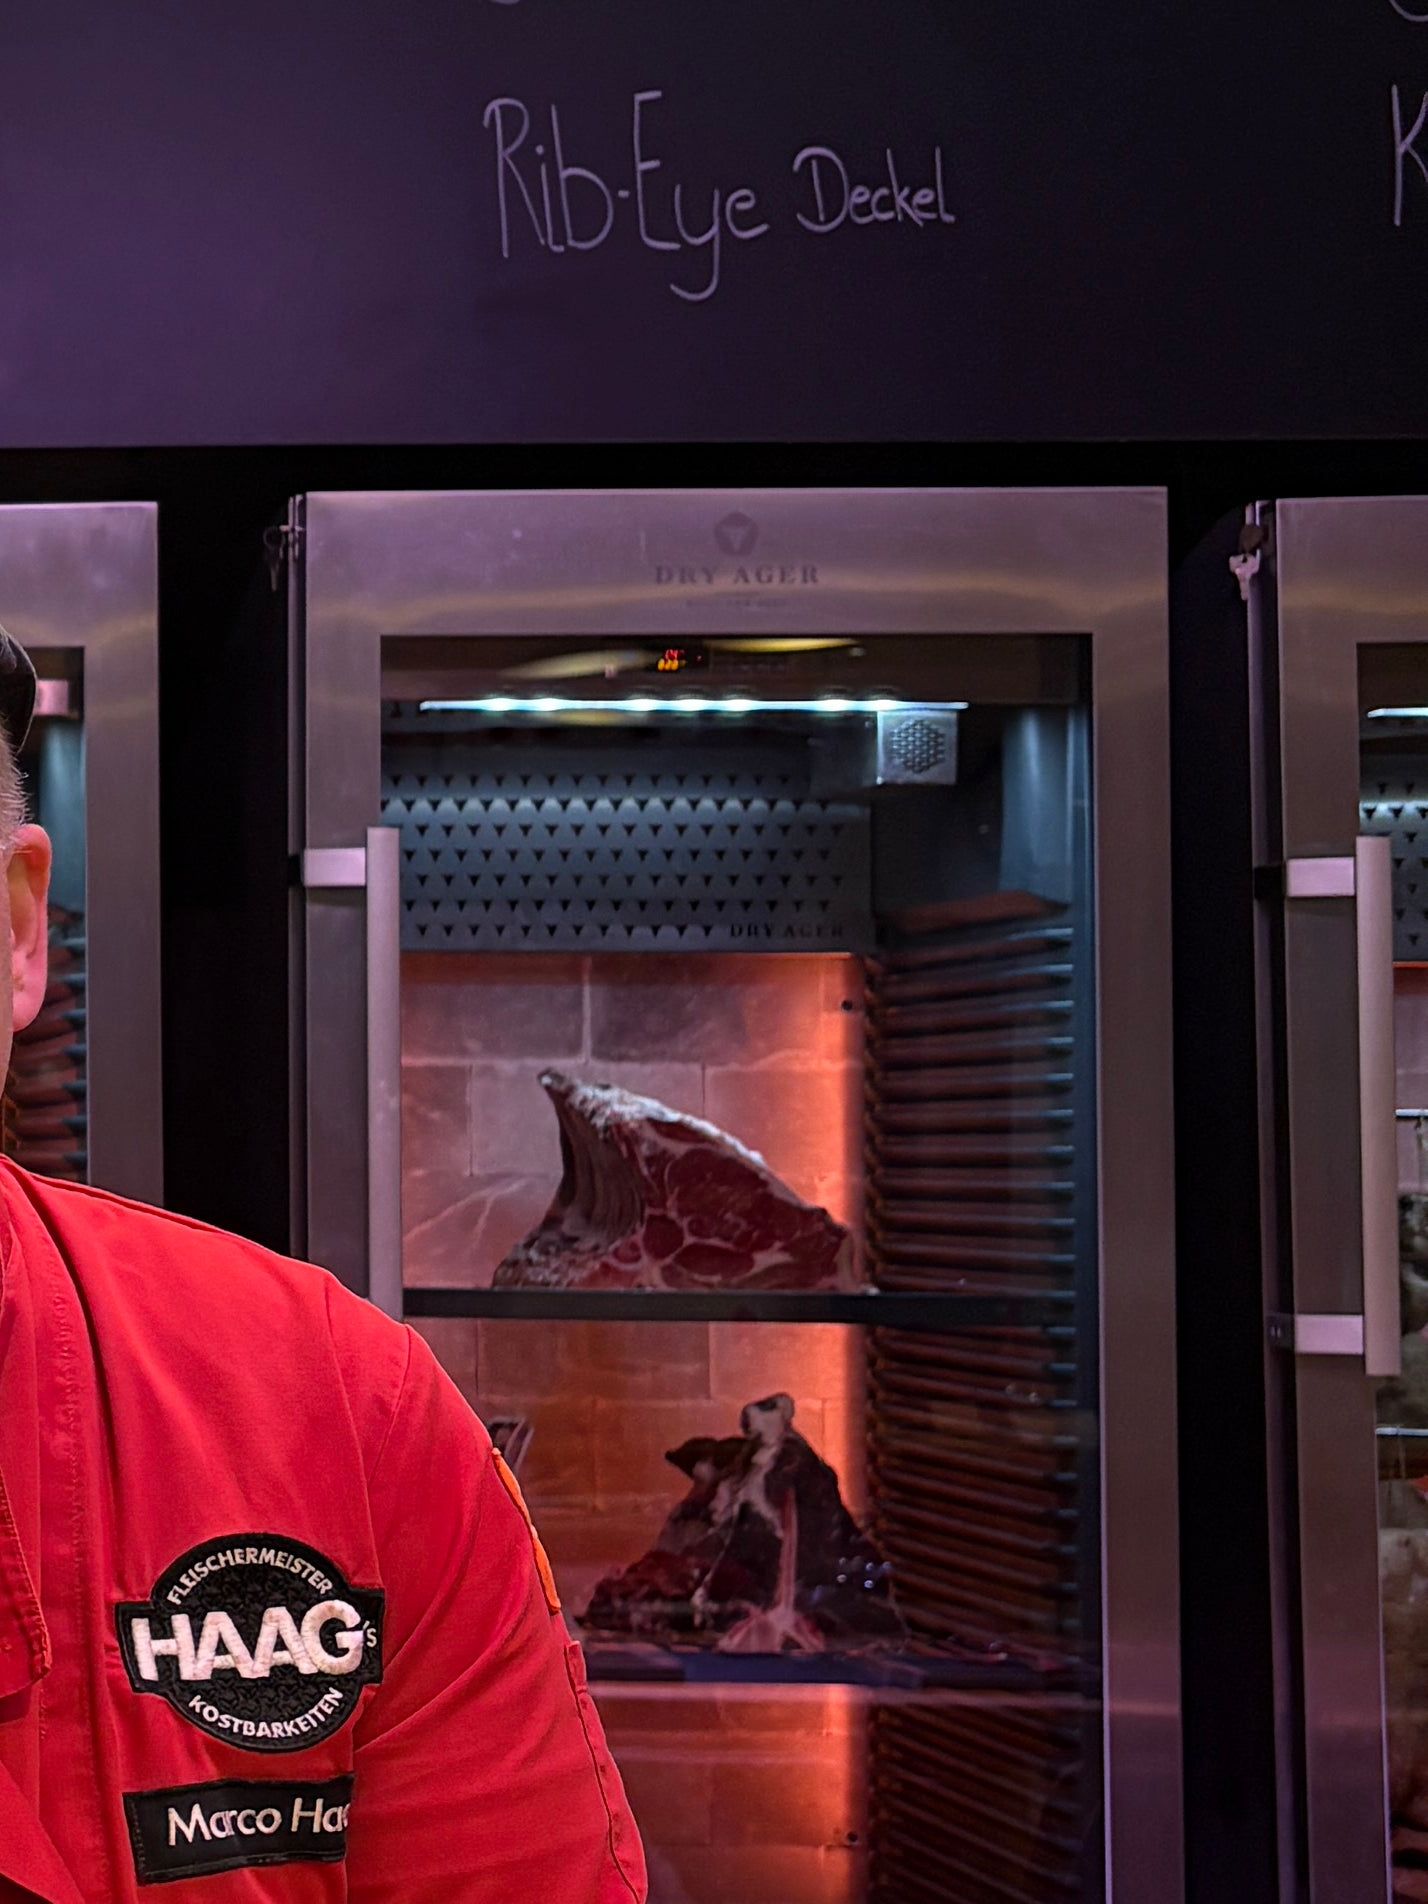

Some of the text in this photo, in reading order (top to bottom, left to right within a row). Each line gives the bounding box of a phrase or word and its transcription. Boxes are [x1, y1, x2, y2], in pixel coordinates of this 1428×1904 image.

[483, 90, 958, 301] Rib-Eye Deckel
[655, 563, 819, 585] DRY AGER
[165, 1547, 334, 1607] FLEISCHERMEISTER
[187, 1686, 344, 1739] KOSTBARKEITEN
[167, 1801, 284, 1848] Marco
